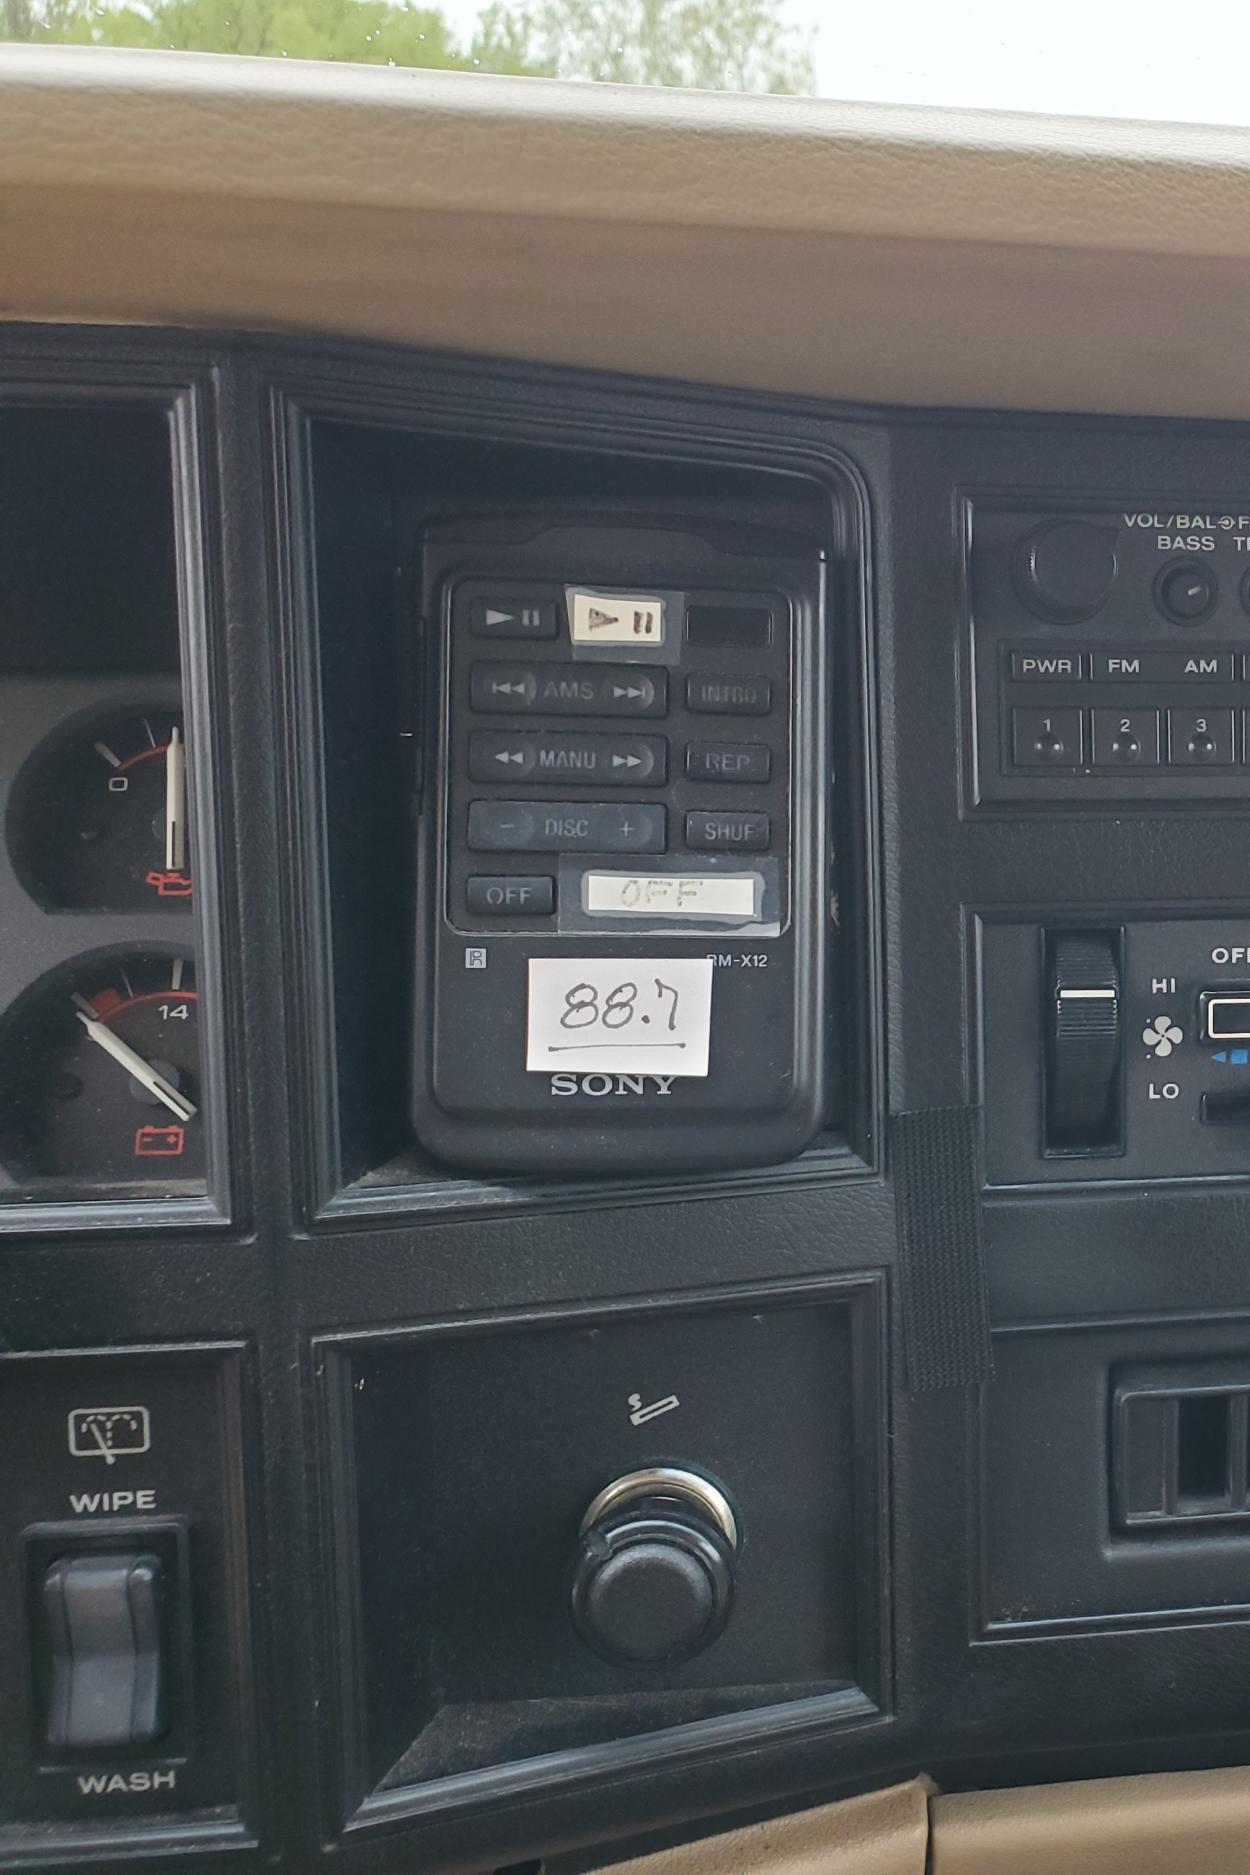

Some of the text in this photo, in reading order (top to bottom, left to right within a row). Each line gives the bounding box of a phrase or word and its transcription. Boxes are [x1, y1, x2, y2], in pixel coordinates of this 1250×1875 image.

[1156, 535, 1216, 551] BASS
[1022, 658, 1072, 673] PWR
[1108, 658, 1140, 673] FM
[1184, 659, 1218, 673] AM
[544, 681, 594, 700] AMS
[702, 685, 756, 703] INTRO
[1042, 718, 1052, 732] 1
[1120, 718, 1130, 732] 2
[1196, 719, 1207, 732] 3
[540, 749, 597, 770] MANU
[705, 753, 751, 770] REP
[544, 819, 589, 837] DISC
[704, 822, 754, 841] SHUF
[486, 886, 532, 906] OFF
[619, 879, 704, 908] OFF
[1151, 978, 1176, 994] HI
[158, 1005, 189, 1020] 14
[559, 977, 679, 1031] 88.7
[551, 1074, 677, 1096] SONY
[1149, 1083, 1180, 1099] LO
[69, 1490, 157, 1513] WIPE
[78, 1771, 176, 1794] WASH
